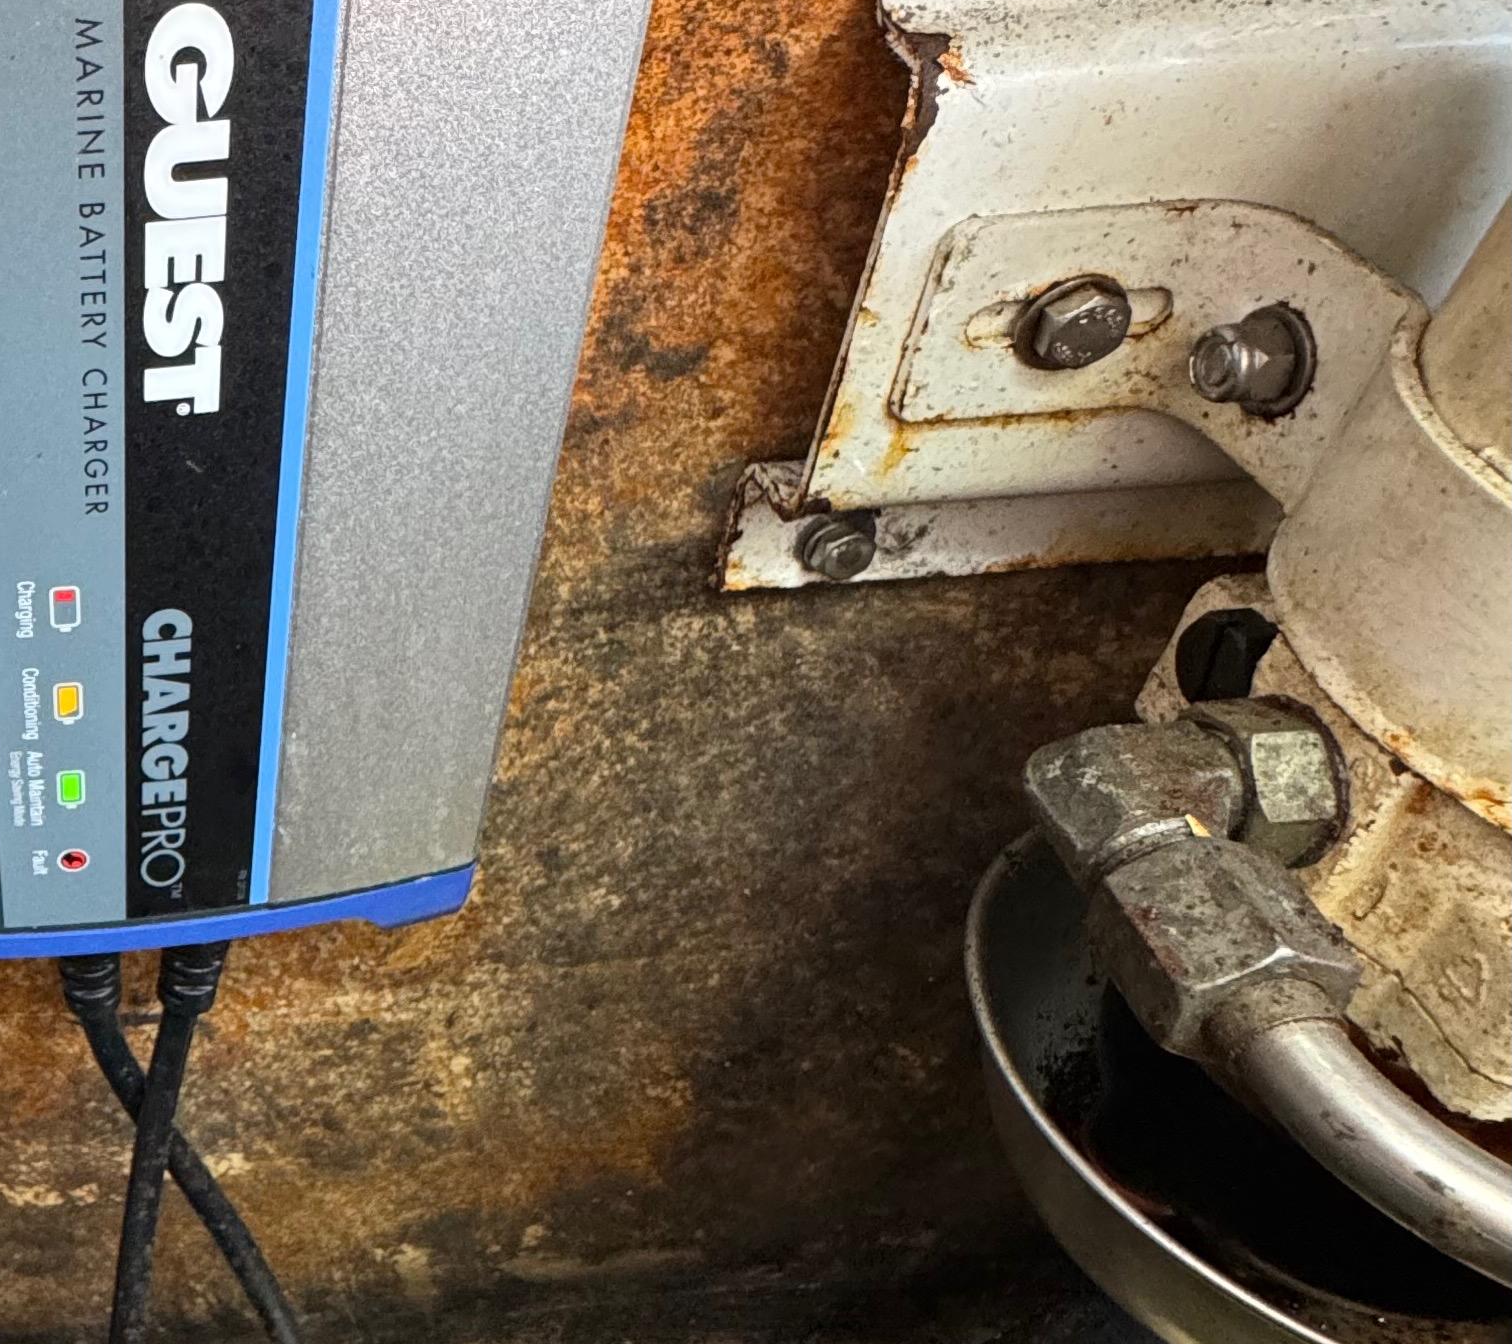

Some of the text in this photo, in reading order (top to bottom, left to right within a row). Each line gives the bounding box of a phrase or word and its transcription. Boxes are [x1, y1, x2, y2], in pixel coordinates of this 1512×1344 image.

[72, 15, 110, 515] MARINE BATTERY CHARGER
[12, 580, 37, 638] Charging
[17, 667, 42, 740] Conditioning
[25, 750, 46, 826] Auto Maintain
[31, 849, 49, 875] Fault
